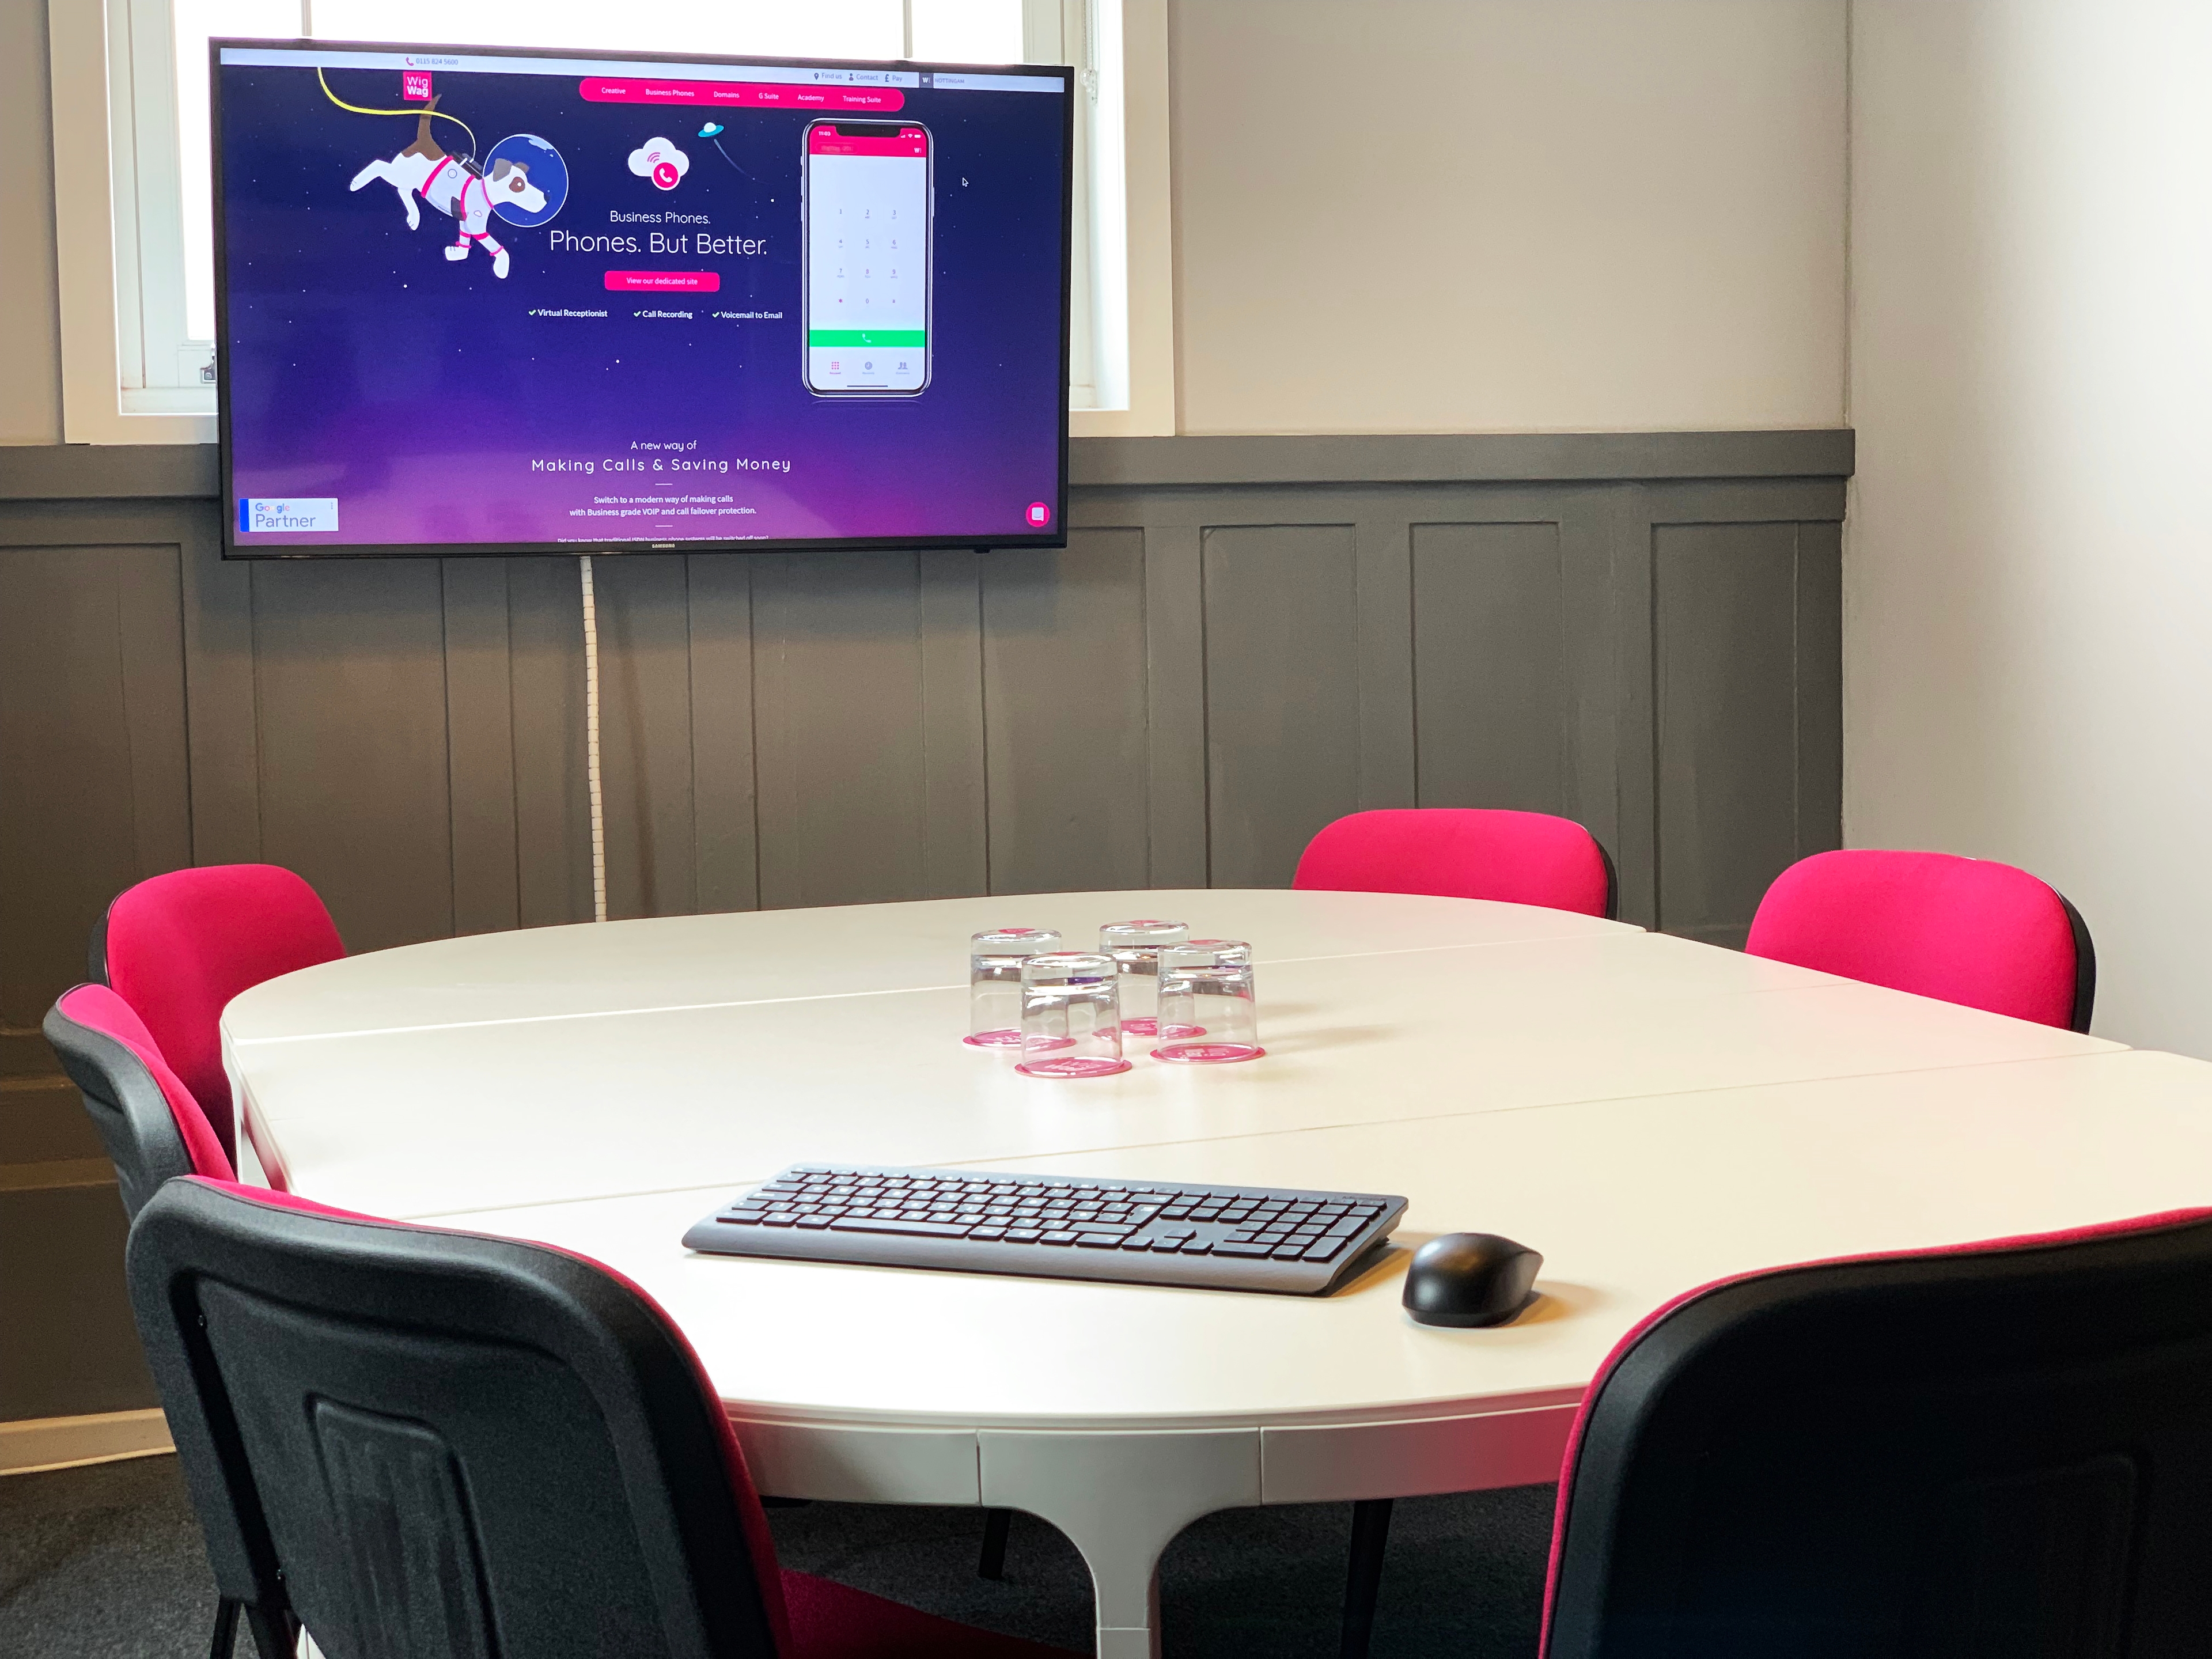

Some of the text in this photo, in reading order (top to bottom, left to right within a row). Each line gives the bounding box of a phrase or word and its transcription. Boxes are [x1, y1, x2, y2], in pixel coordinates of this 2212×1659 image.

[407, 76, 429, 88] Wig
[407, 85, 429, 98] Wag
[645, 88, 672, 97] Business
[713, 90, 740, 99] Domains
[797, 94, 824, 103] Academy
[842, 95, 866, 104] Training
[610, 210, 711, 224] Business Phones.
[550, 229, 767, 255] Phones. But Better.
[626, 276, 642, 285] View
[654, 277, 685, 286] dedicated
[687, 278, 698, 286] site
[537, 309, 608, 318] Virtual Receptionist
[642, 310, 693, 320] Call Recording
[721, 311, 754, 319] Voicemail
[630, 440, 697, 453] A new way of
[532, 458, 791, 475] Making Calls & Saving Money
[593, 496, 619, 504] Switch
[635, 495, 664, 504] modern
[680, 495, 689, 503] of
[689, 495, 716, 505] making
[717, 495, 734, 503] calls
[255, 502, 290, 514] Google
[569, 508, 586, 516] with
[587, 508, 620, 517] Business
[620, 508, 641, 517] grade
[661, 507, 675, 516] and
[690, 507, 717, 515] failover
[718, 506, 757, 516] protection.
[255, 513, 316, 528] Partner
